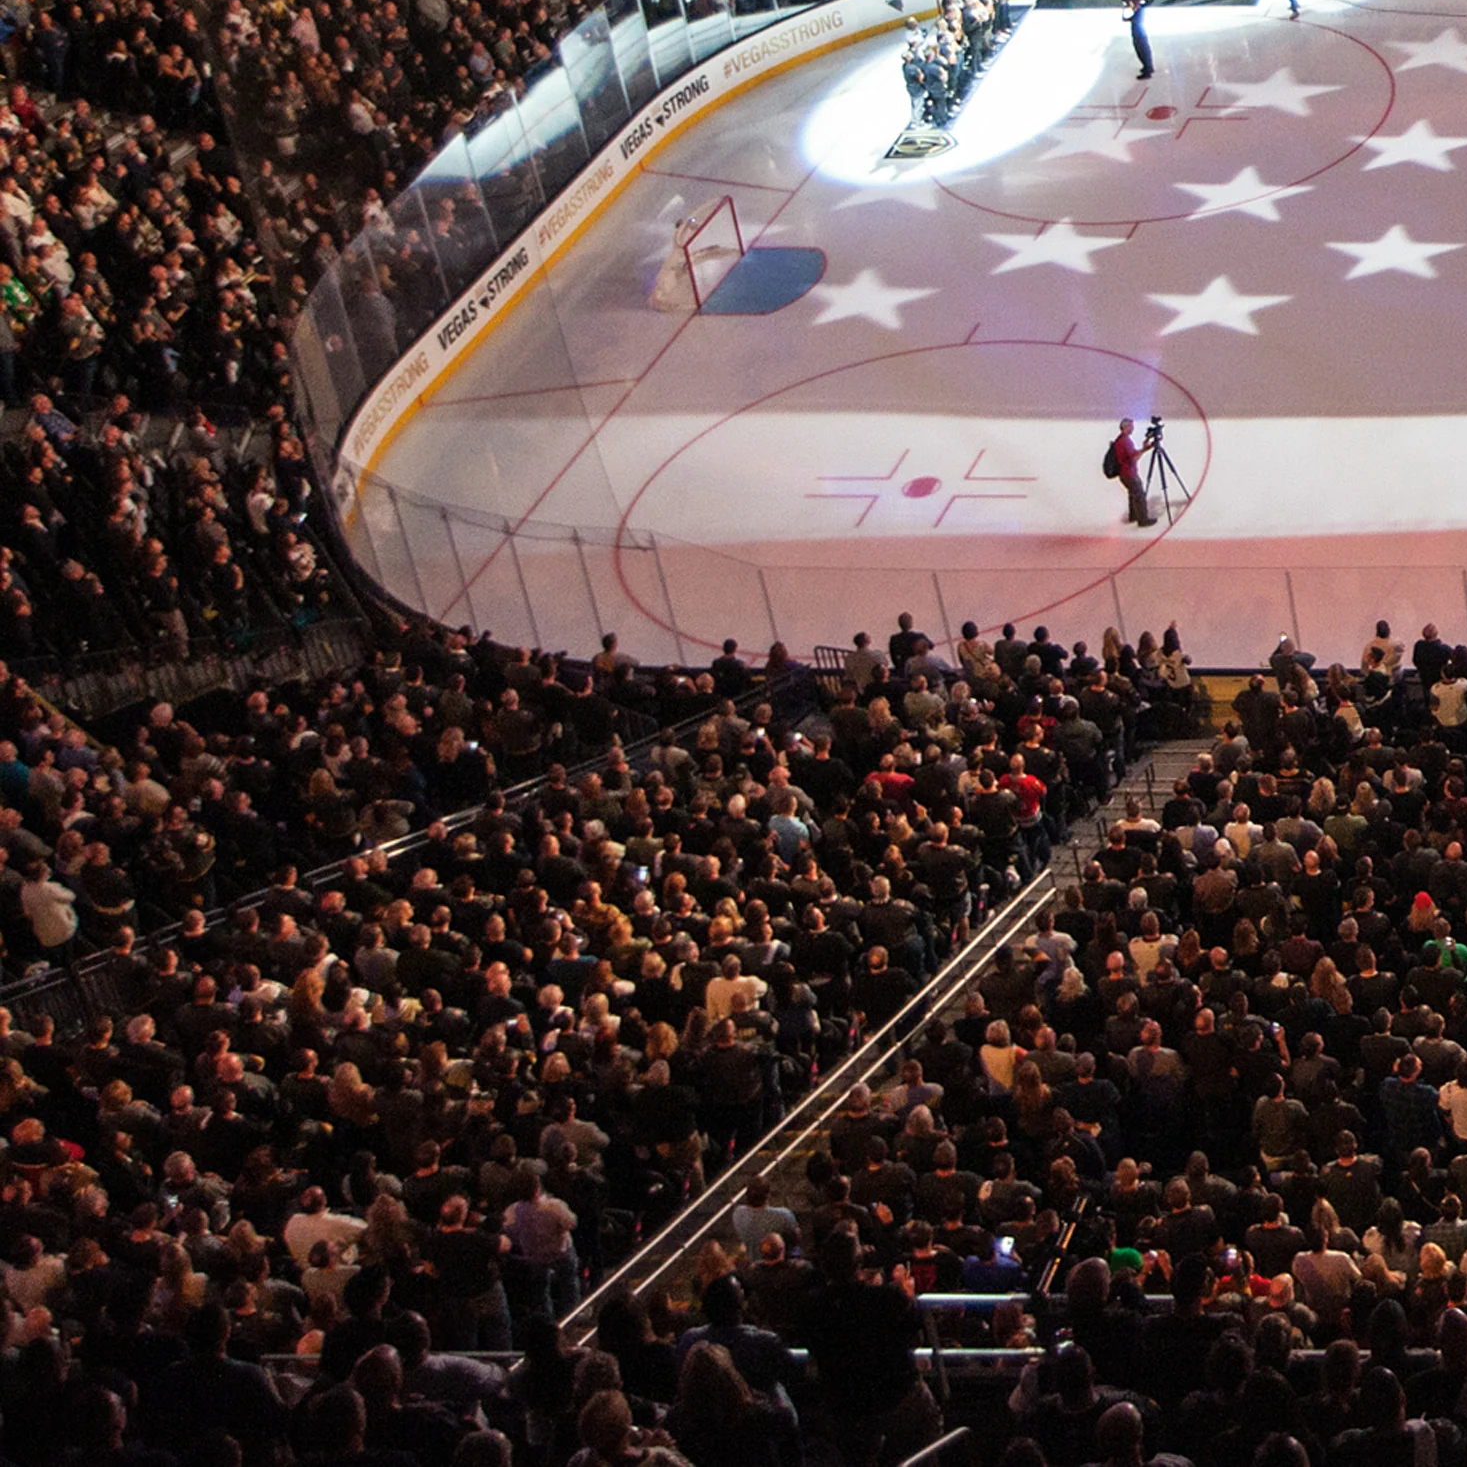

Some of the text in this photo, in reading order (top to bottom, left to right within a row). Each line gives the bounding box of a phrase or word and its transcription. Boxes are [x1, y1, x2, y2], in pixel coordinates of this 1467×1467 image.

[722, 10, 844, 79] #VEGASSTRONG
[619, 74, 711, 161] VEGAS STRONG
[437, 247, 529, 352] VEGAS STRONG
